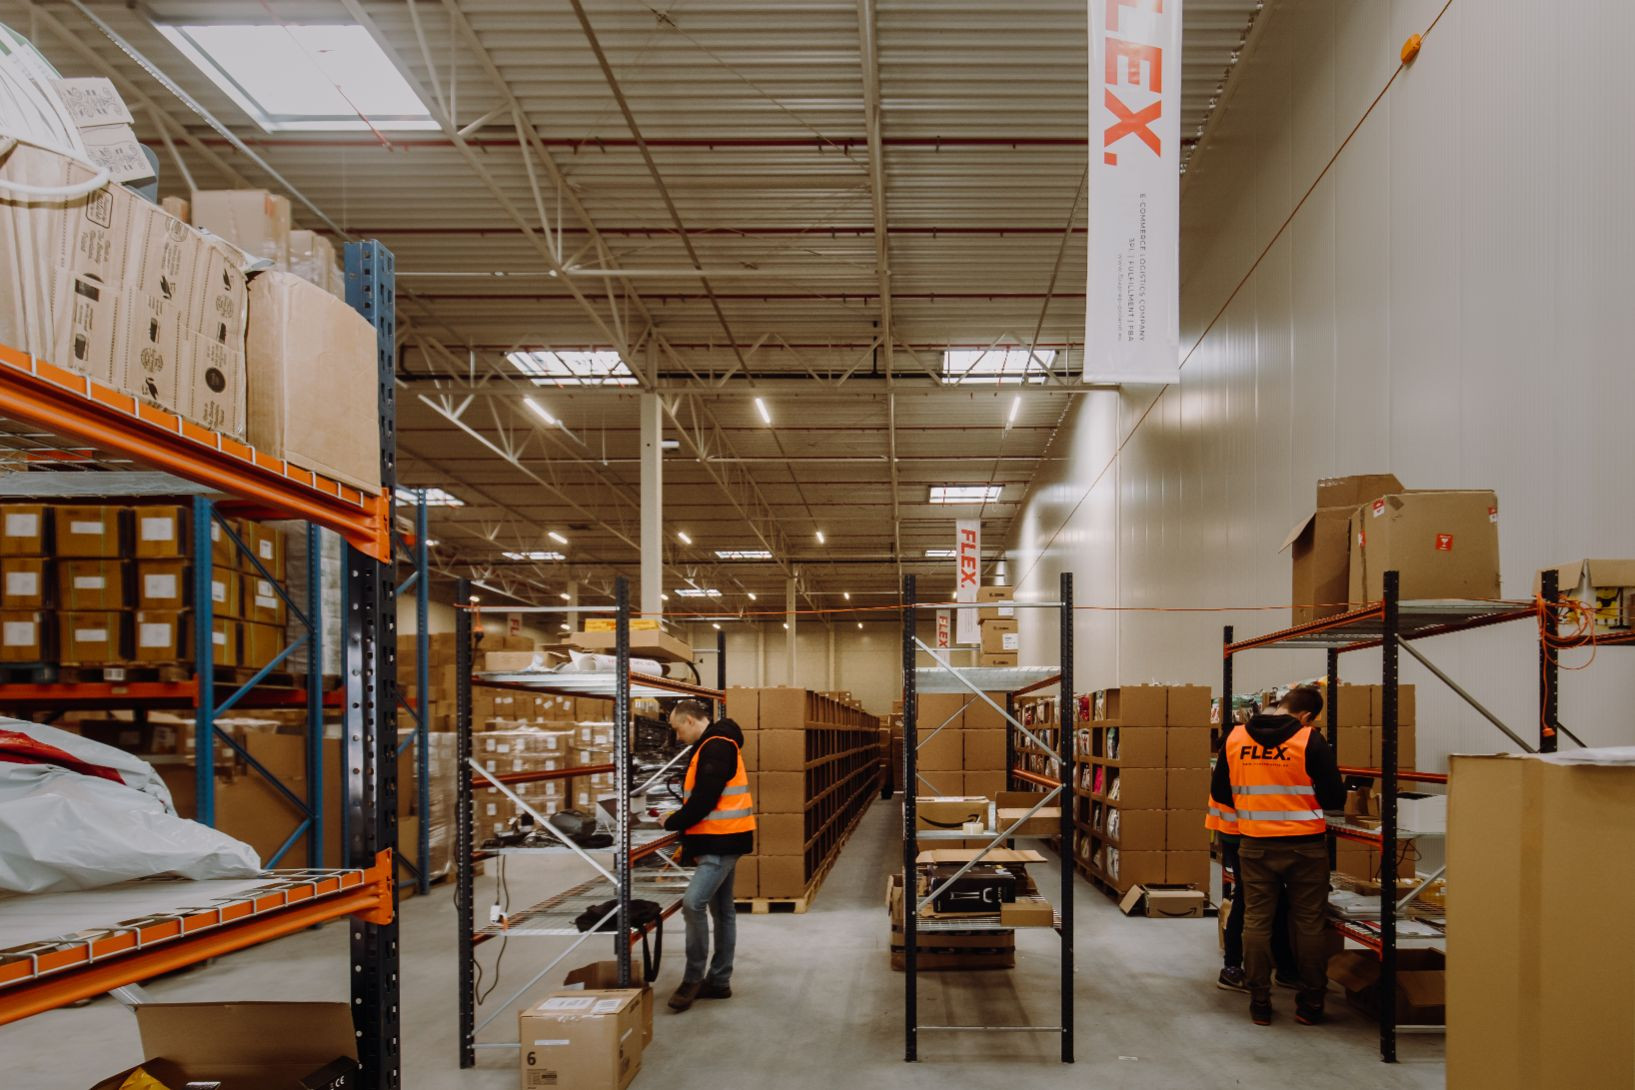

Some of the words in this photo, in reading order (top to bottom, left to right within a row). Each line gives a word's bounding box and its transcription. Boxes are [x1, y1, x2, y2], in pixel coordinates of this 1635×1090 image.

[1139, 193, 1147, 252] E-COMMERCE
[1139, 254, 1147, 297] LOGISTICS
[1138, 299, 1147, 342] COMPANY
[961, 529, 977, 589] FLEX.
[1240, 745, 1291, 761] FLEX.
[527, 1051, 536, 1065] 6
